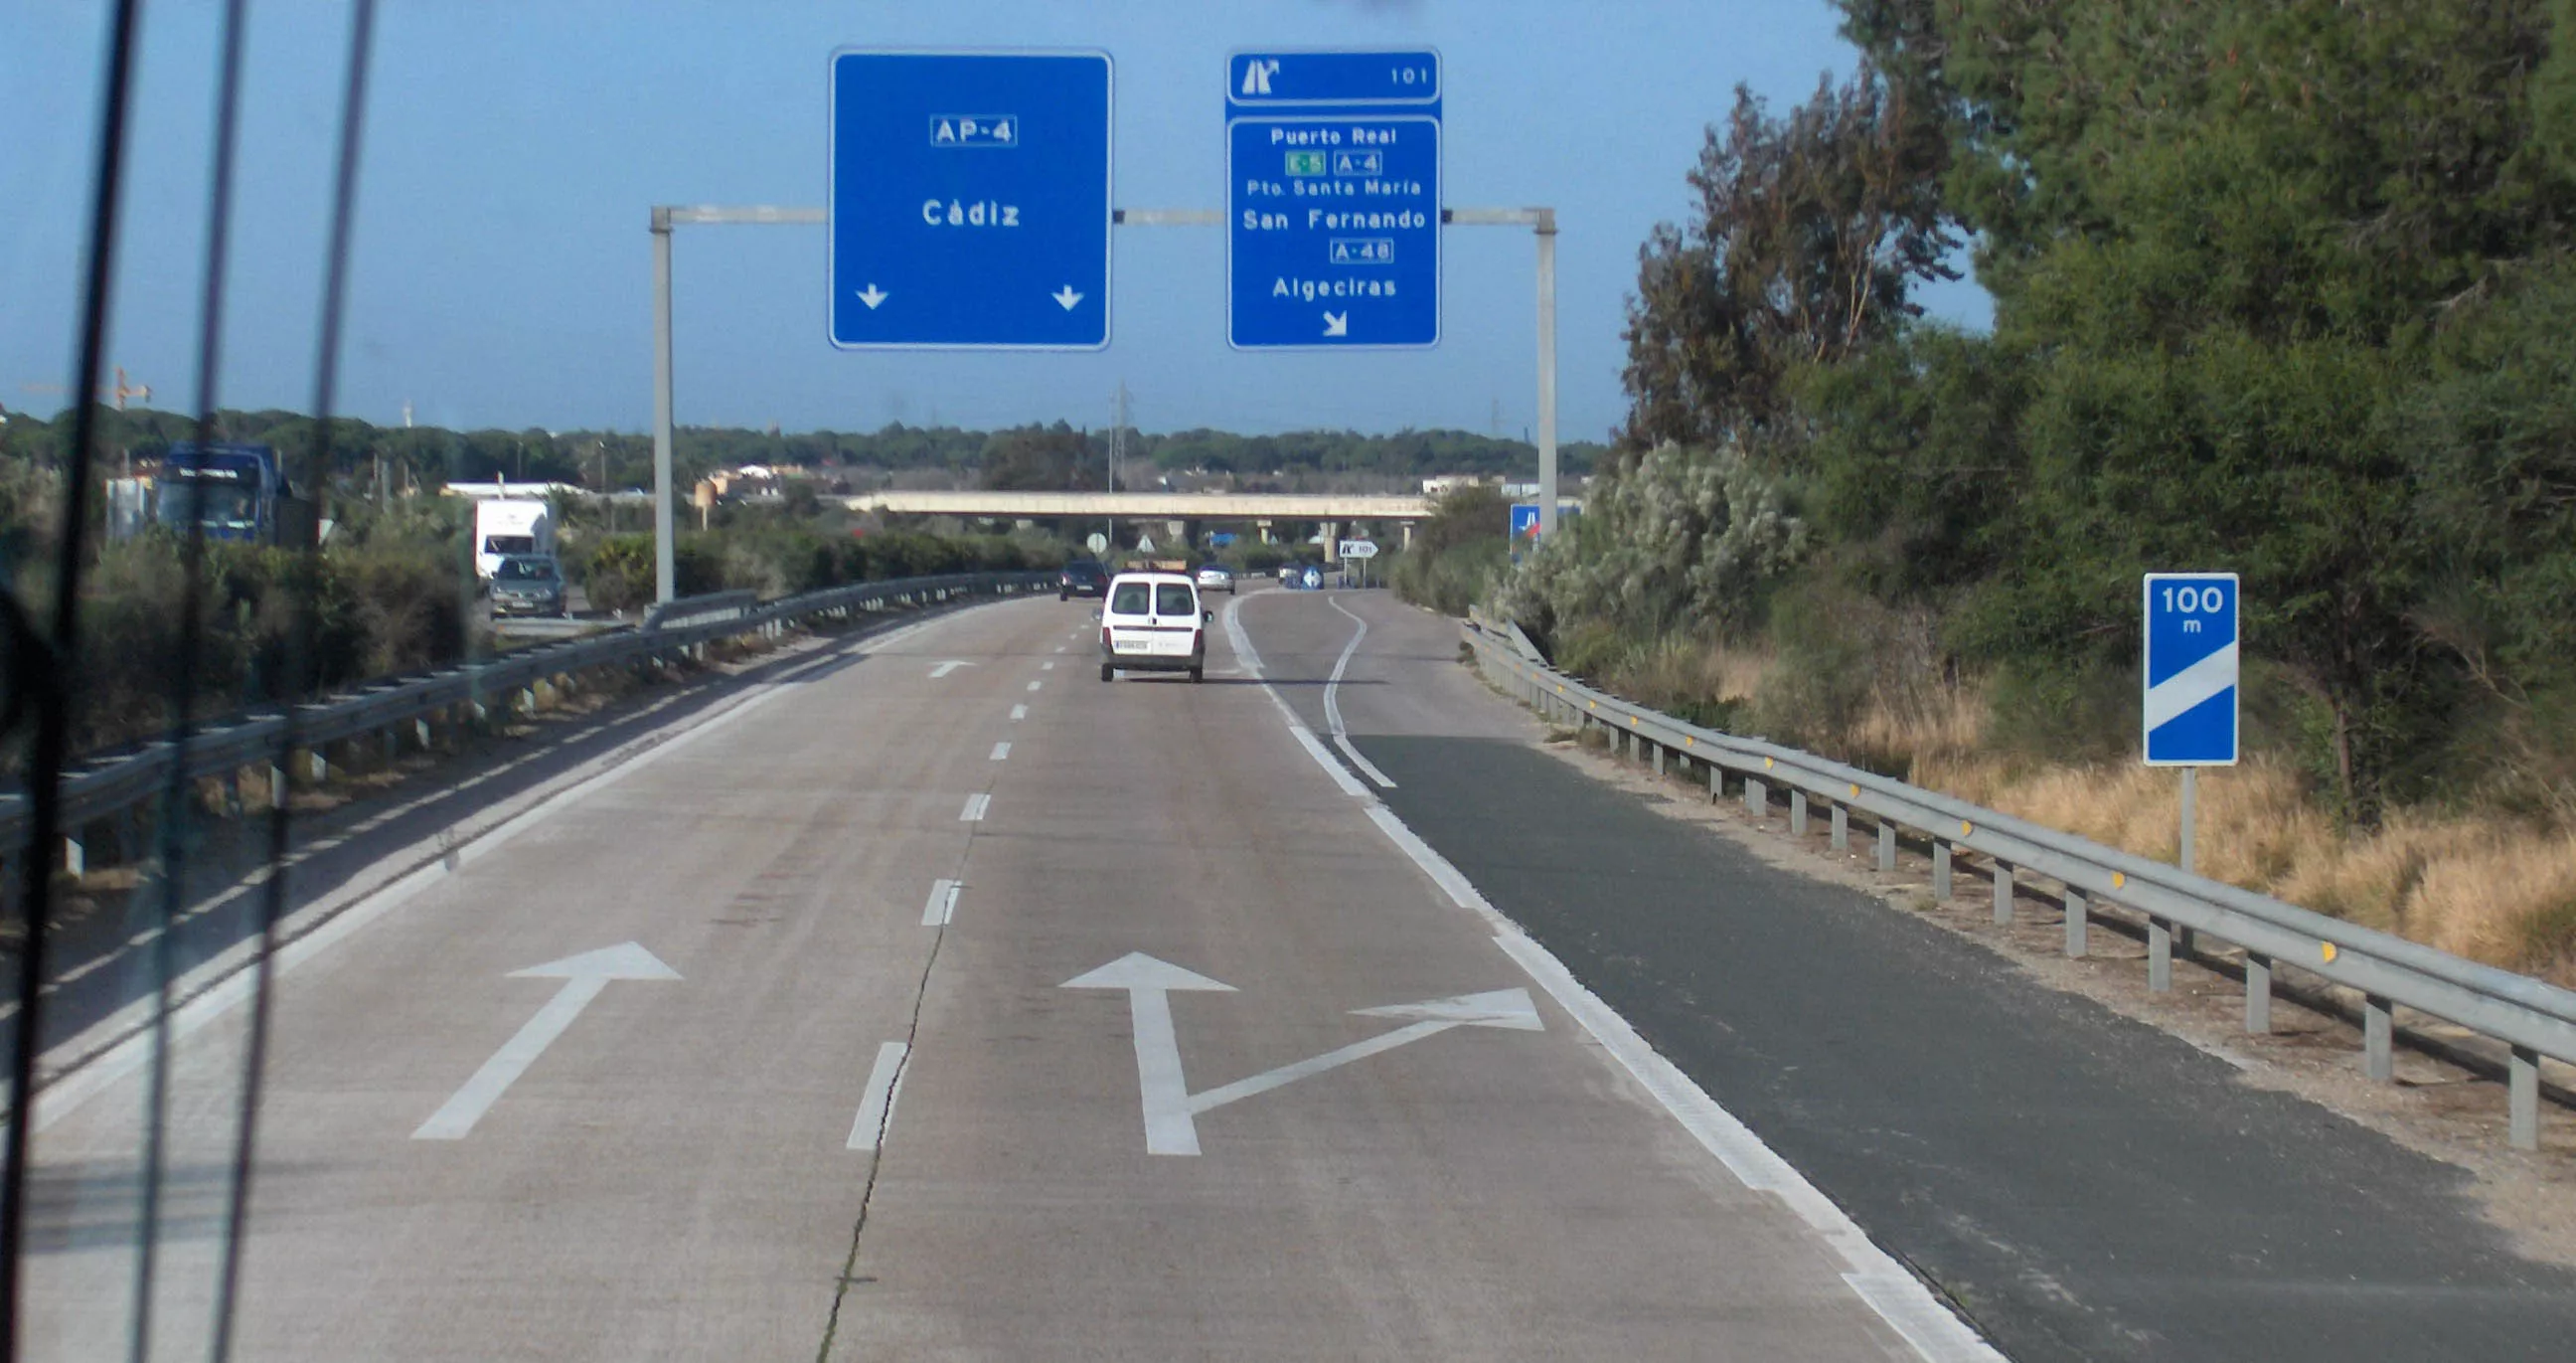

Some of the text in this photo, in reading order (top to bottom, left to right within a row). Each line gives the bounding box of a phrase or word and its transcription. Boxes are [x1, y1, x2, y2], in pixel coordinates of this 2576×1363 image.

[1391, 68, 1427, 85] 101
[936, 118, 1012, 142] AP-4
[1271, 127, 1396, 145] Puerto Real
[1339, 154, 1378, 172] A-4
[1294, 179, 1355, 196] Santa
[1243, 208, 1425, 230] San Fernando
[1272, 277, 1396, 302] Algeciras
[2163, 586, 2223, 613] 100
[2182, 619, 2201, 633] m
